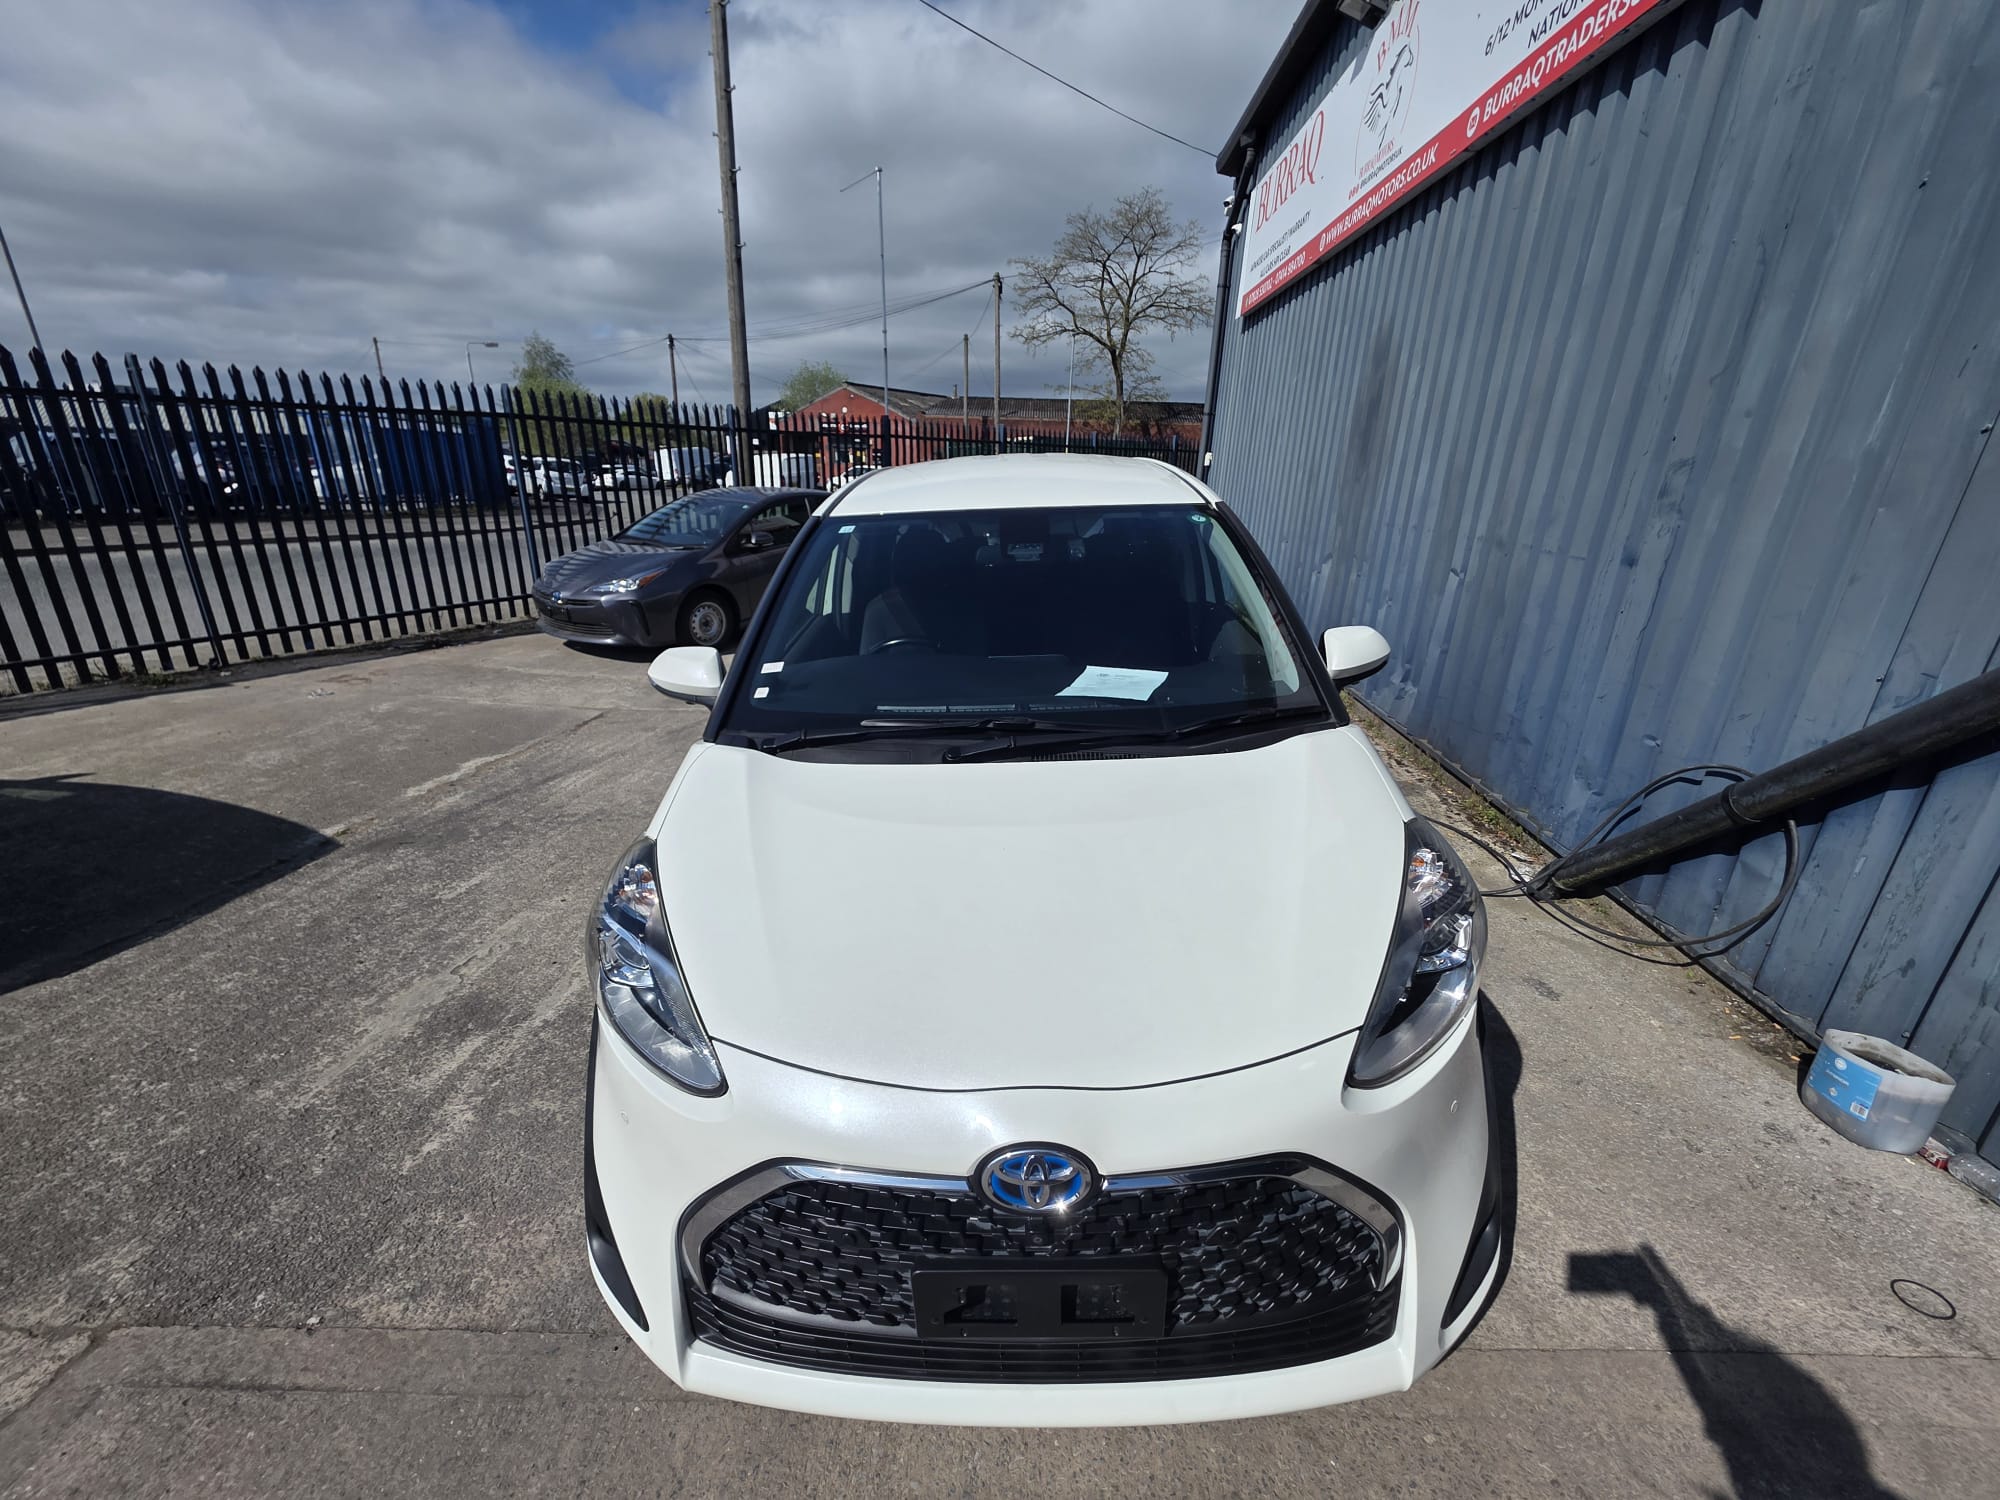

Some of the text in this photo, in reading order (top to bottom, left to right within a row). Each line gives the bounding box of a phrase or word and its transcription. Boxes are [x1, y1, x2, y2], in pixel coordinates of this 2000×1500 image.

[1483, 0, 1639, 122] BURRAQTRADERS
[1484, 17, 1512, 56] 6/12
[1256, 110, 1324, 233] BURRAQ
[1326, 142, 1440, 244] WWW.BURRAQMOTORS.CO.UK
